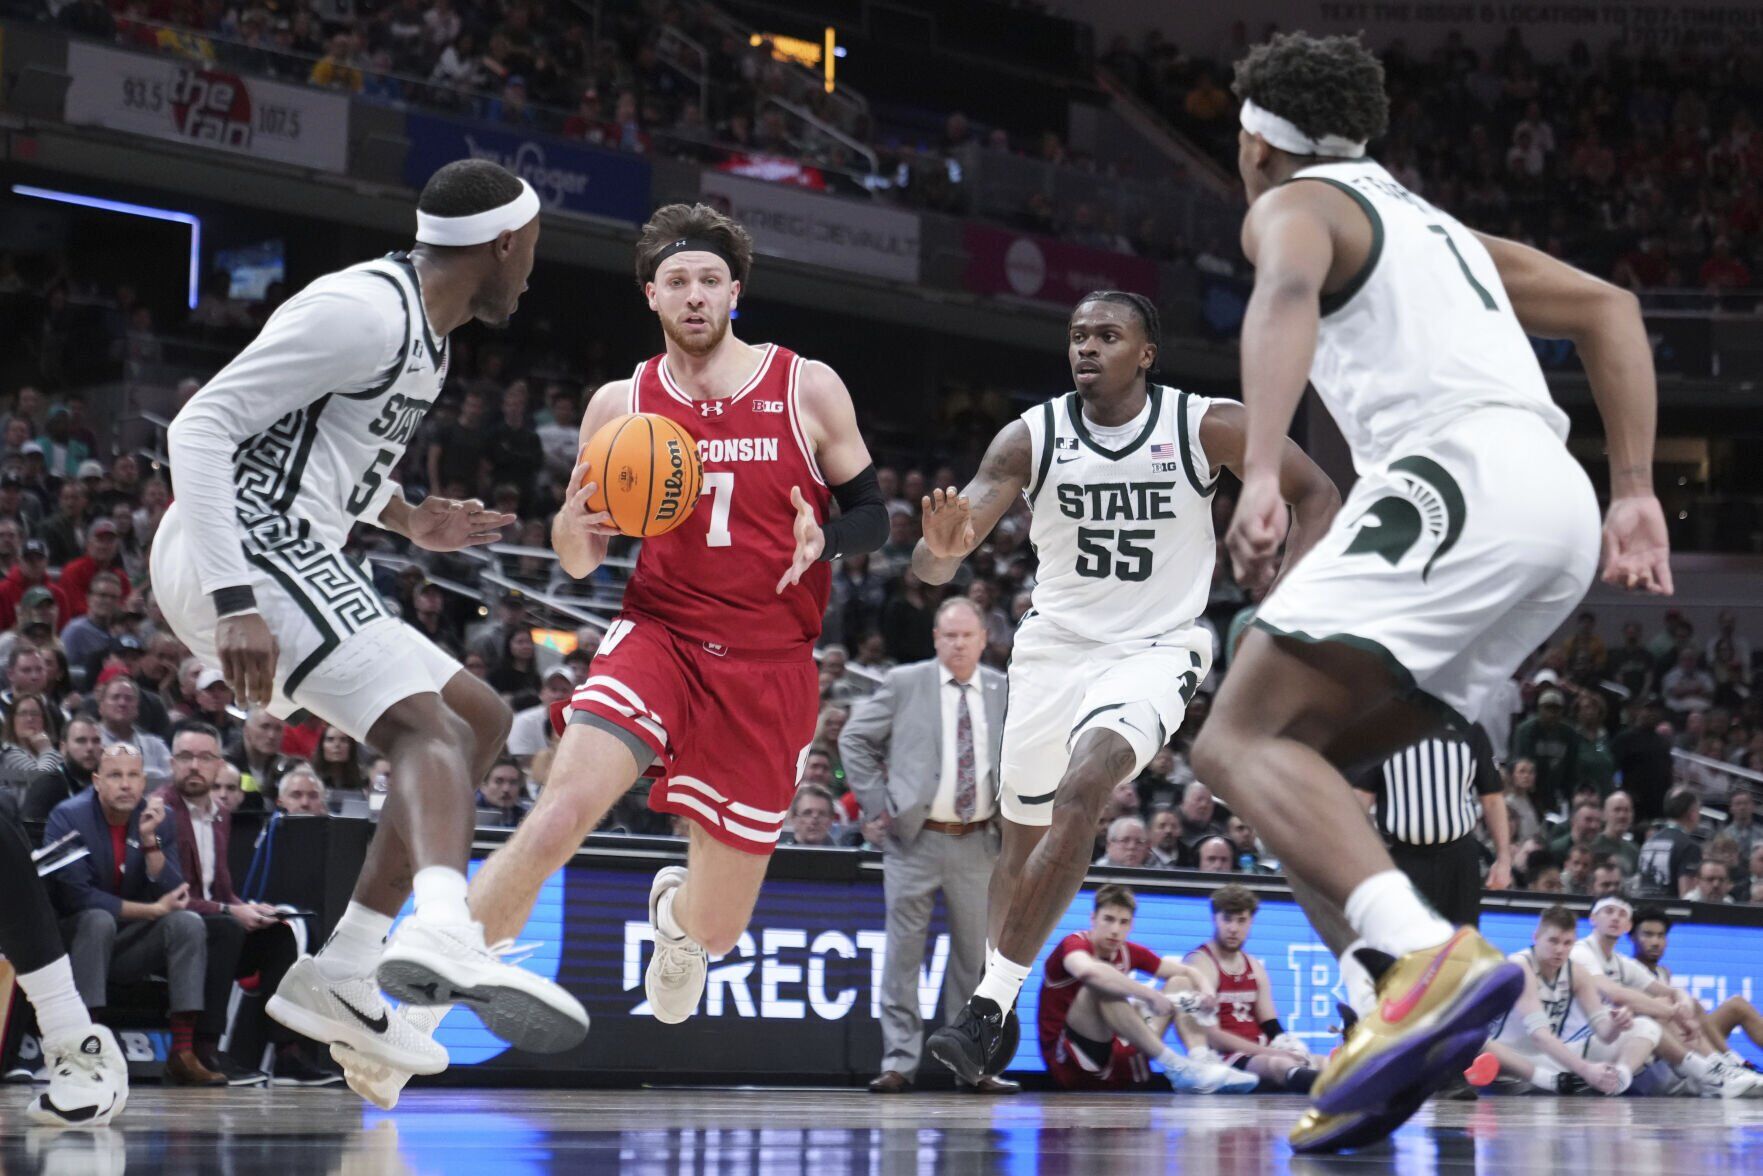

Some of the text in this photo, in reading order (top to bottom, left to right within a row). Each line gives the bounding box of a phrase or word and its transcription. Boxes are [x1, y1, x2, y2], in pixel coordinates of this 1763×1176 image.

[122, 76, 165, 113] 93.5
[173, 67, 236, 113] the
[182, 101, 253, 146] fan
[258, 104, 300, 141] 107.5
[345, 448, 396, 516] 5
[655, 438, 684, 521] Wilson
[1056, 481, 1177, 521] STATE
[700, 472, 735, 548] 7
[1074, 525, 1156, 583] 55
[622, 920, 951, 1021] DRECTV
